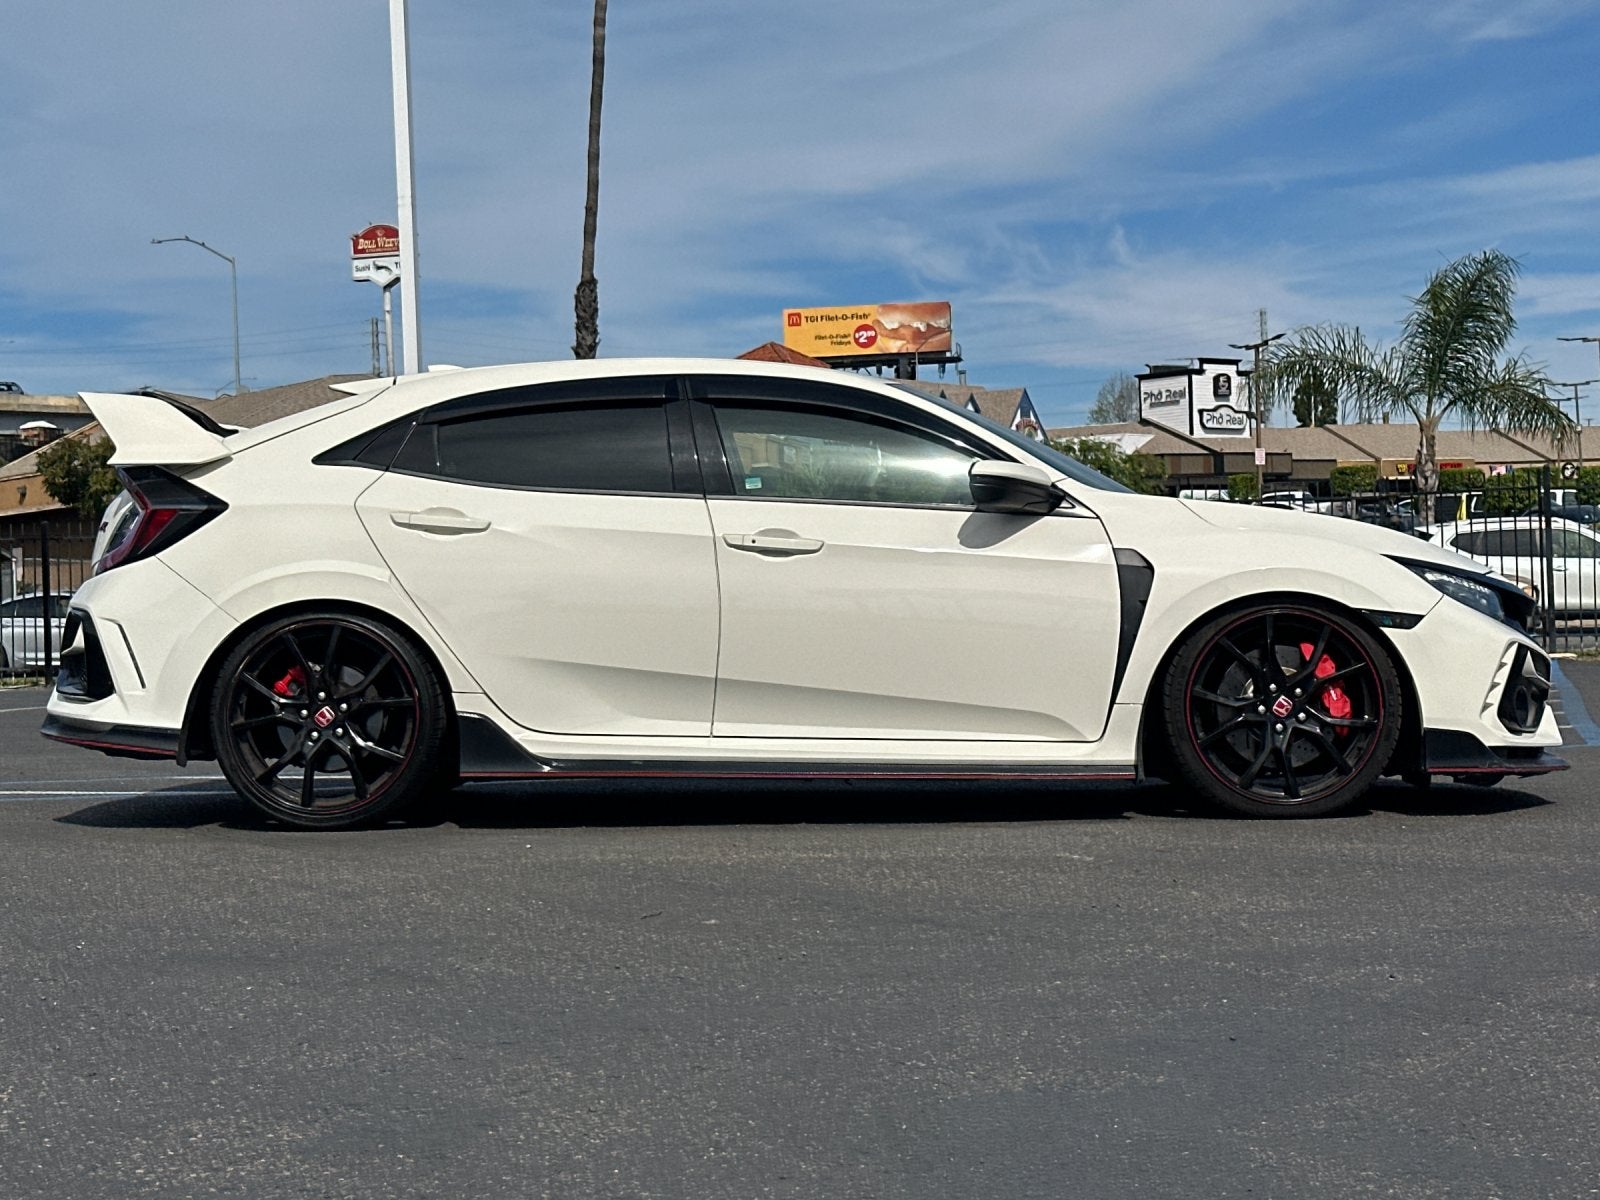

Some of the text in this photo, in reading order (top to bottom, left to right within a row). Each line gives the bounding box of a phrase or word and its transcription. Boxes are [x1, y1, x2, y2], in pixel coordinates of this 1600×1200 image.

[804, 315, 818, 323] TGI
[1165, 387, 1186, 399] Real
[1226, 413, 1244, 426] Real
